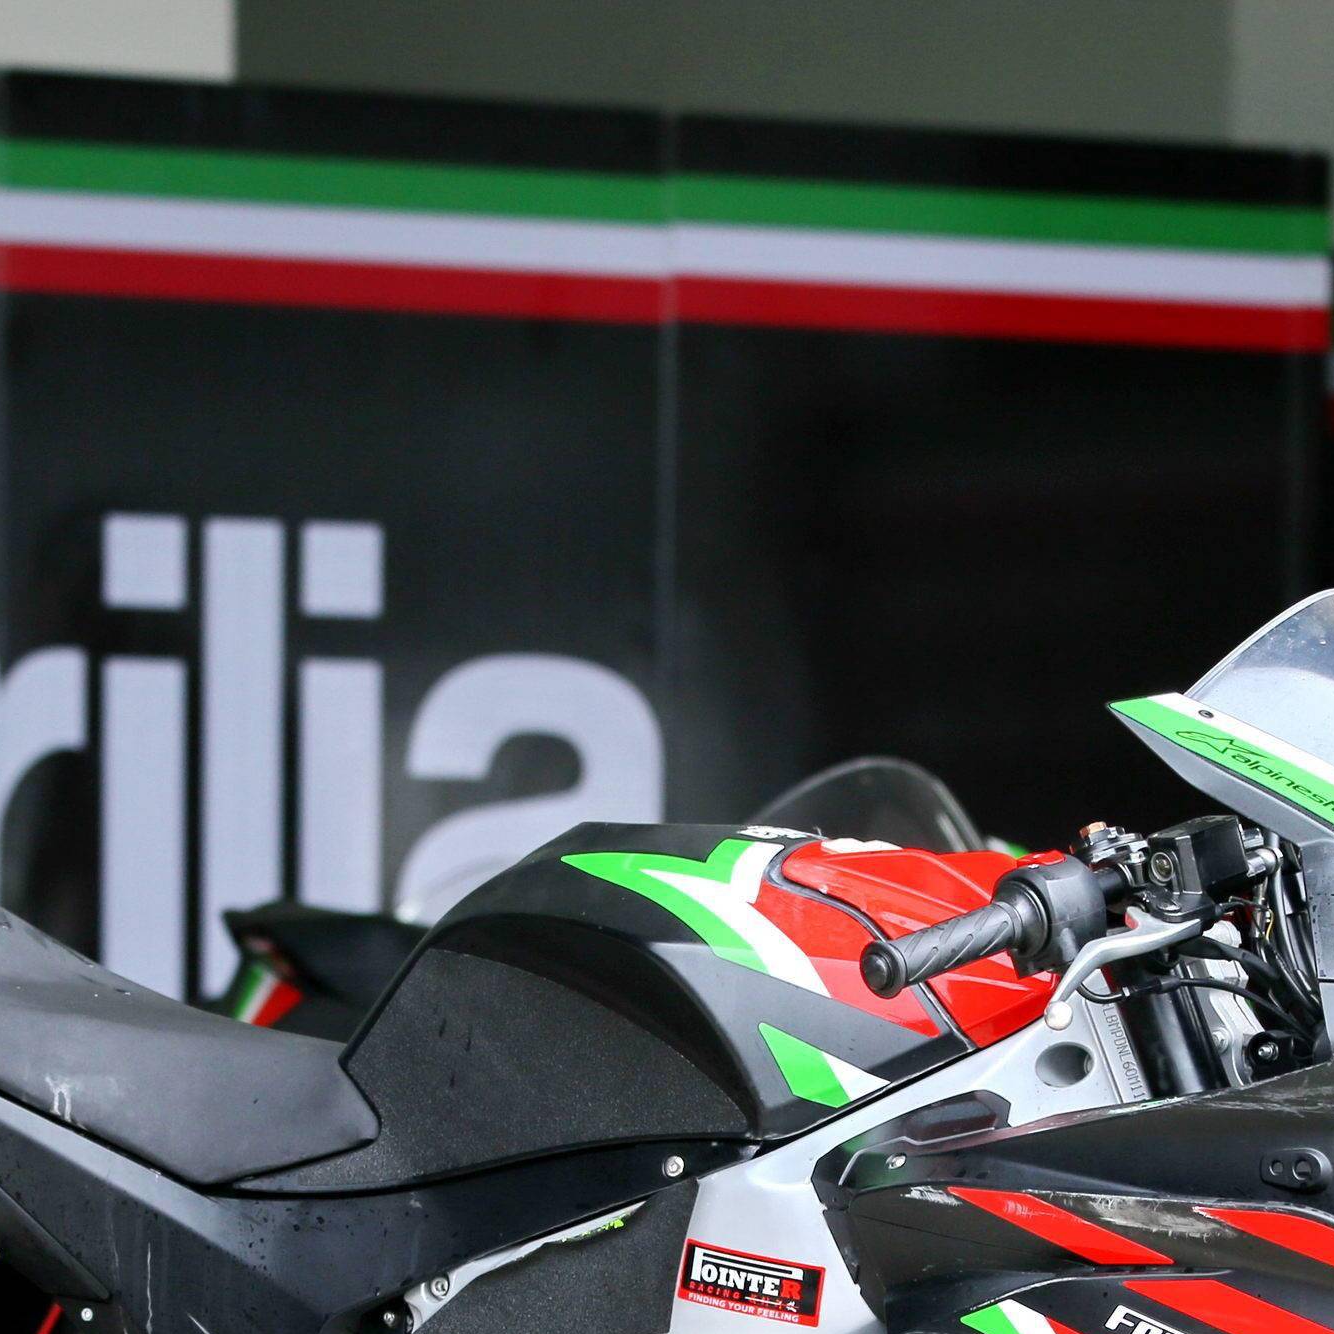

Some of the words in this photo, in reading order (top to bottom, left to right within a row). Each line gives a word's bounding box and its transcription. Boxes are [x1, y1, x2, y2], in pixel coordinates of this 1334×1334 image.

[691, 1246, 804, 1300] POINTER
[689, 1281, 740, 1299] RACING
[688, 1293, 726, 1308] FINDING
[728, 1301, 755, 1315] YOUR
[756, 1307, 799, 1323] FEELING
